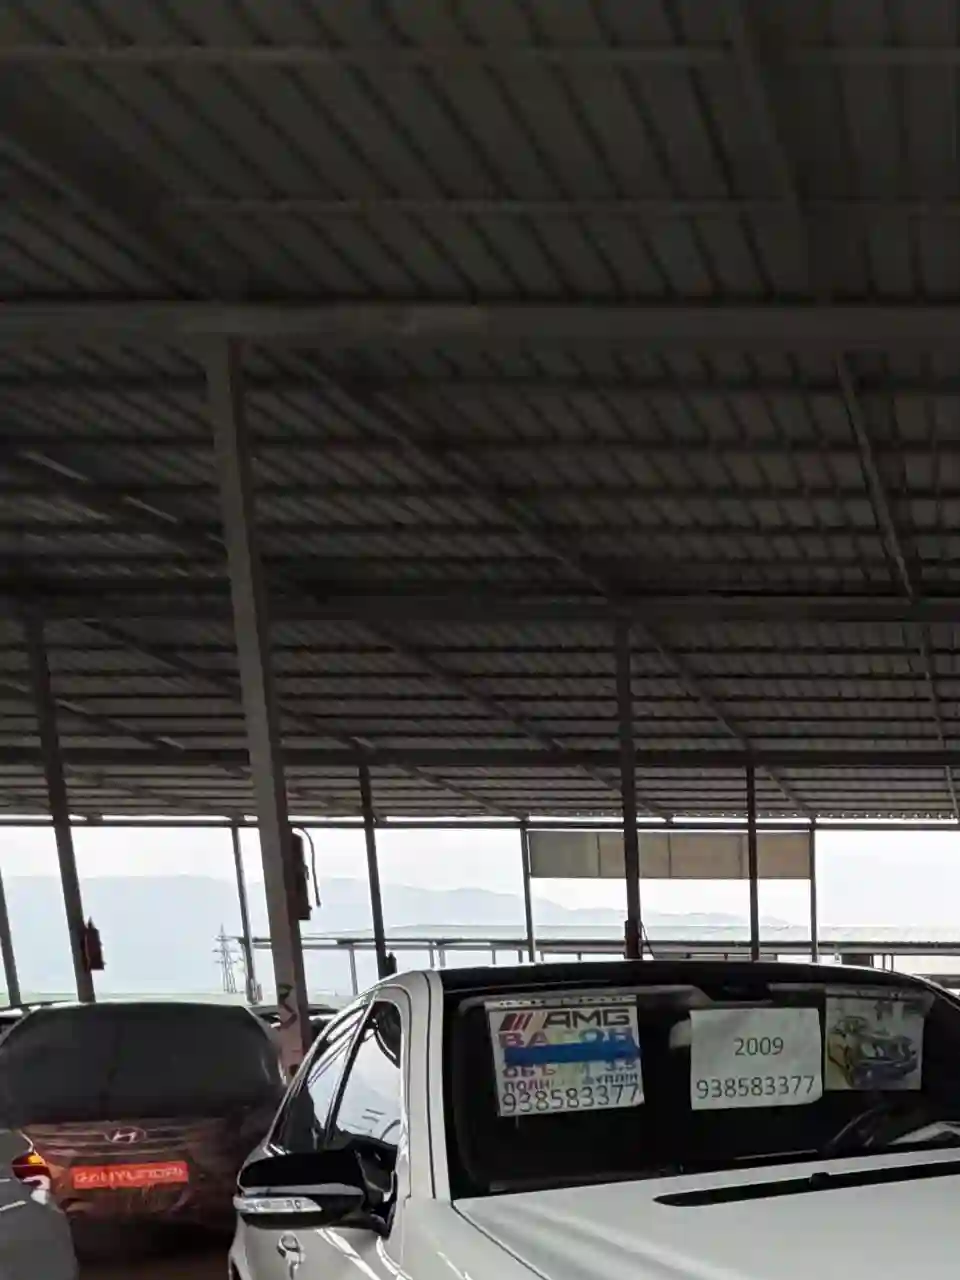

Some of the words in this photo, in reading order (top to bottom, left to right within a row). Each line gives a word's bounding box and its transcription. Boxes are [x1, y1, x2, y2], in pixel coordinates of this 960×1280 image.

[734, 1036, 784, 1056] 2009
[502, 1083, 640, 1114] 938583377
[696, 1075, 815, 1099] 938583377
